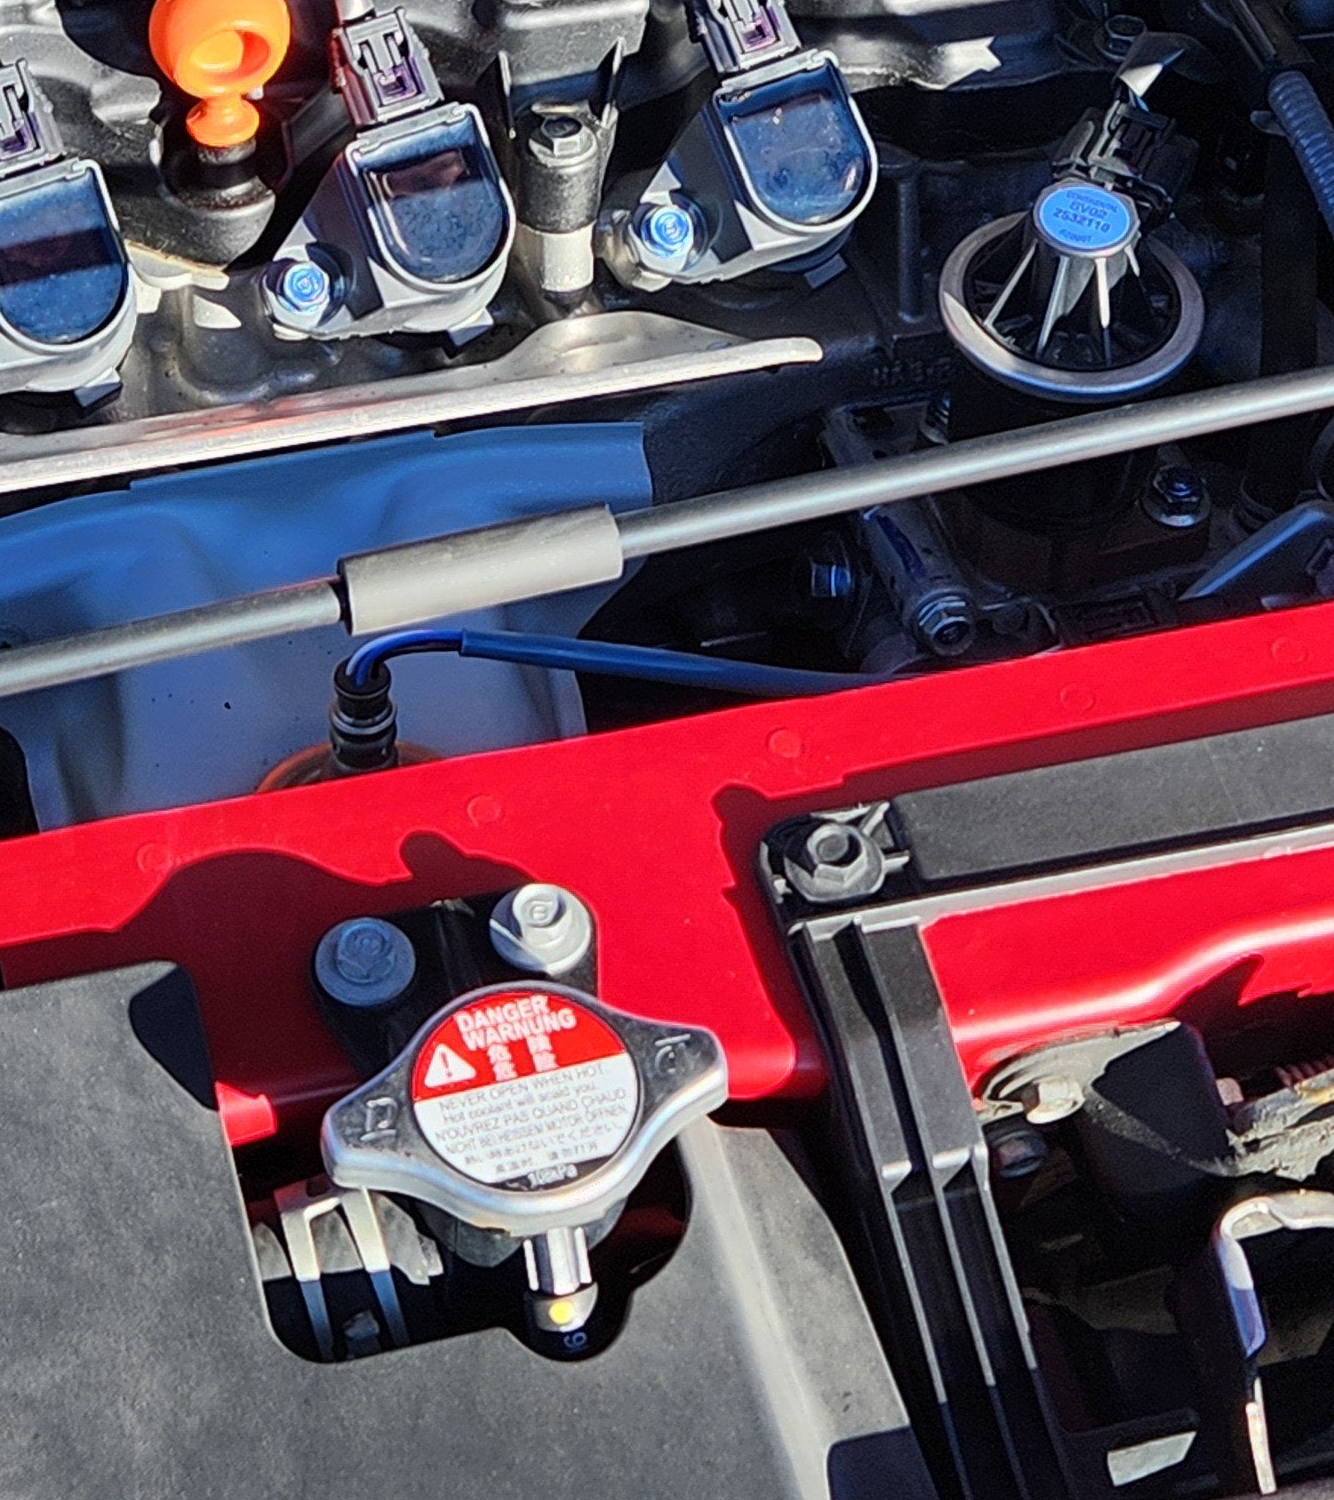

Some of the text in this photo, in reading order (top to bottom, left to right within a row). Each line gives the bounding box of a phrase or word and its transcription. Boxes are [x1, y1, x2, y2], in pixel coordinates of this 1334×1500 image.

[455, 996, 549, 1032] DANGER
[461, 1009, 577, 1050] WARNUNG
[489, 1081, 530, 1102] OPEN
